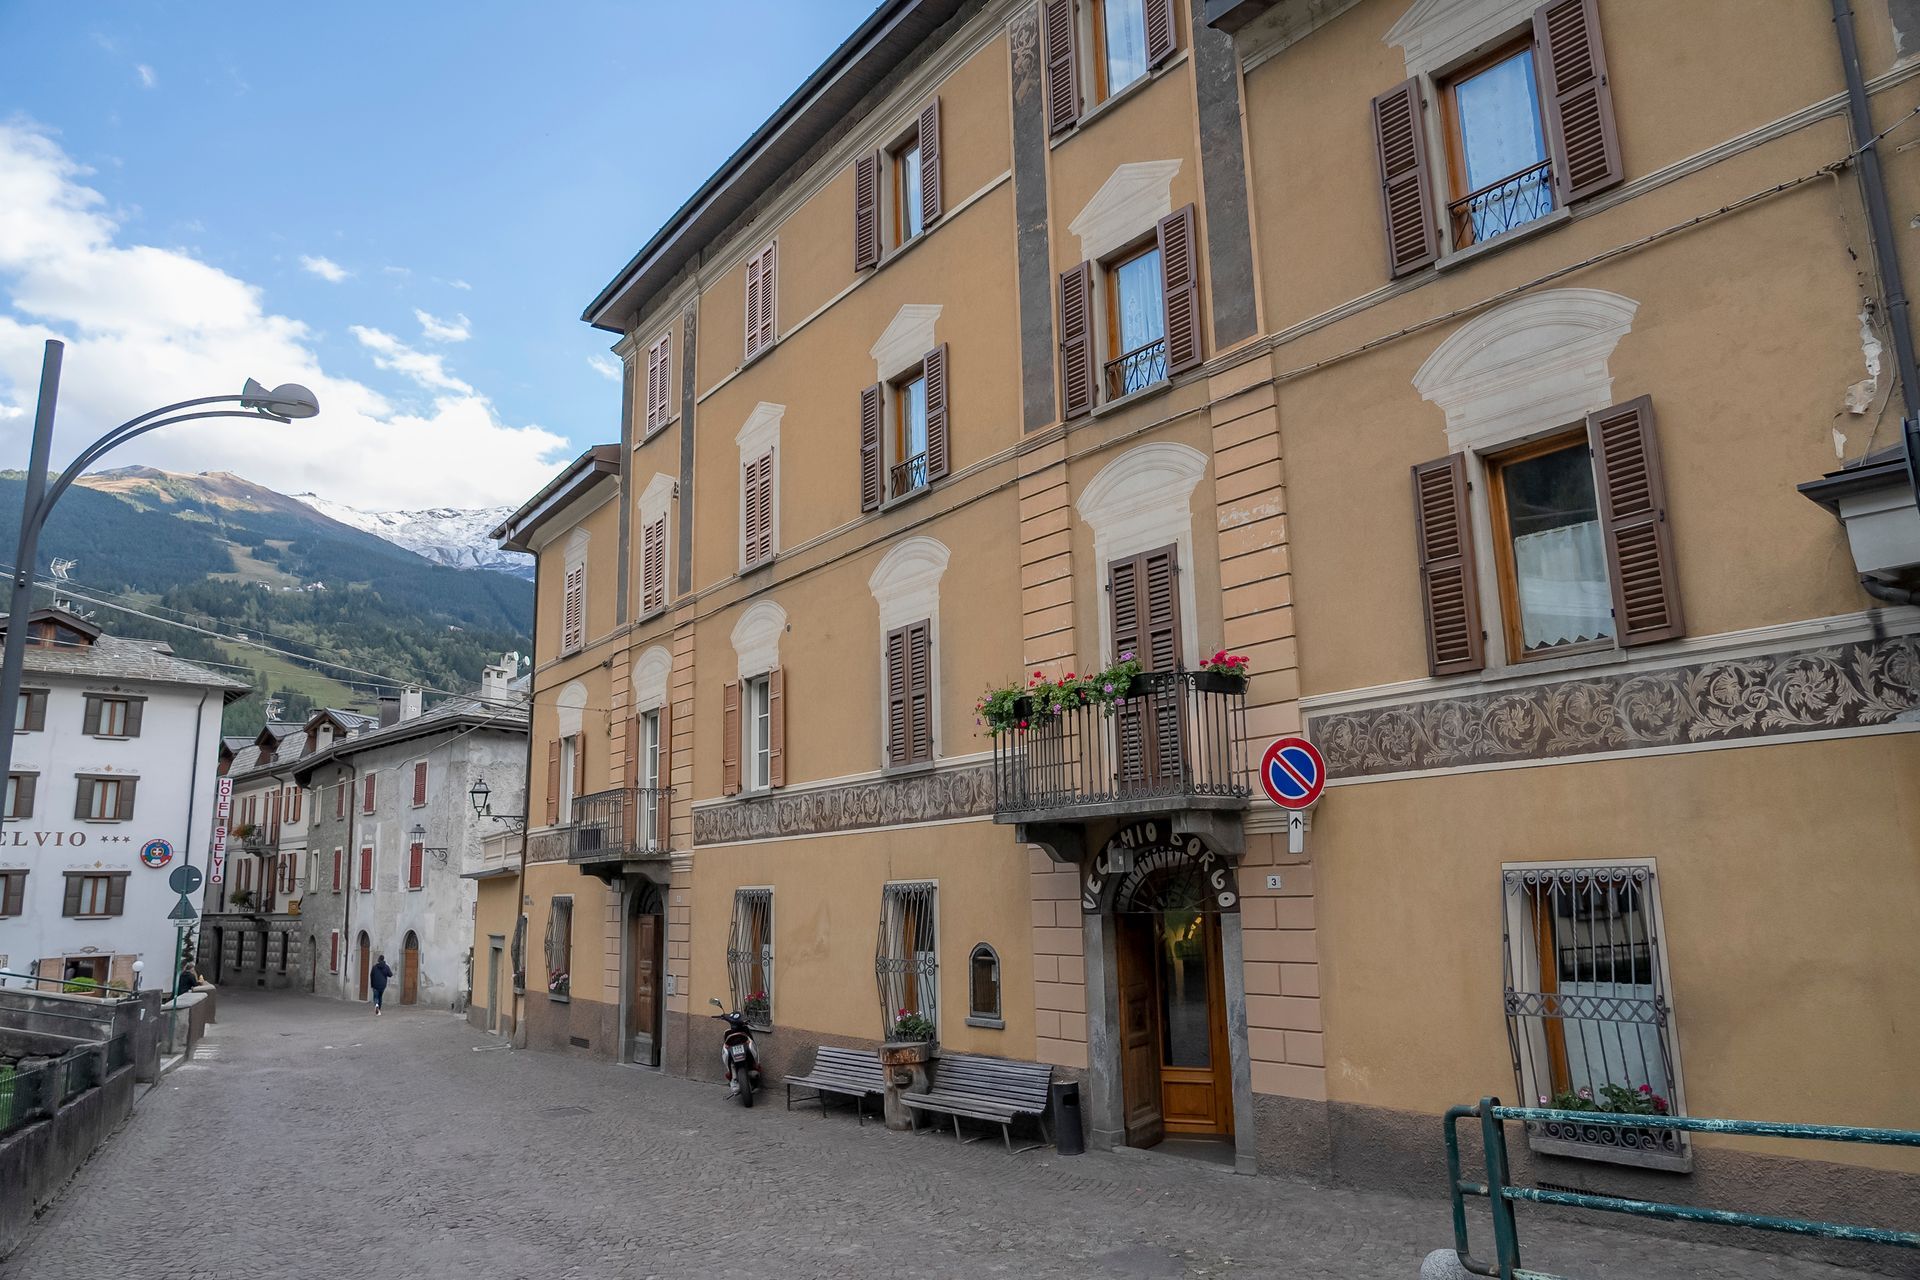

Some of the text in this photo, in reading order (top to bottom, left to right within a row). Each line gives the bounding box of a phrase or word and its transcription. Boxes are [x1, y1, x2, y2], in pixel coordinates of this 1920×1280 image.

[212, 780, 231, 883] HOTEL STELVIO
[1083, 822, 1157, 909] VECHIO
[1271, 878, 1277, 886] 3
